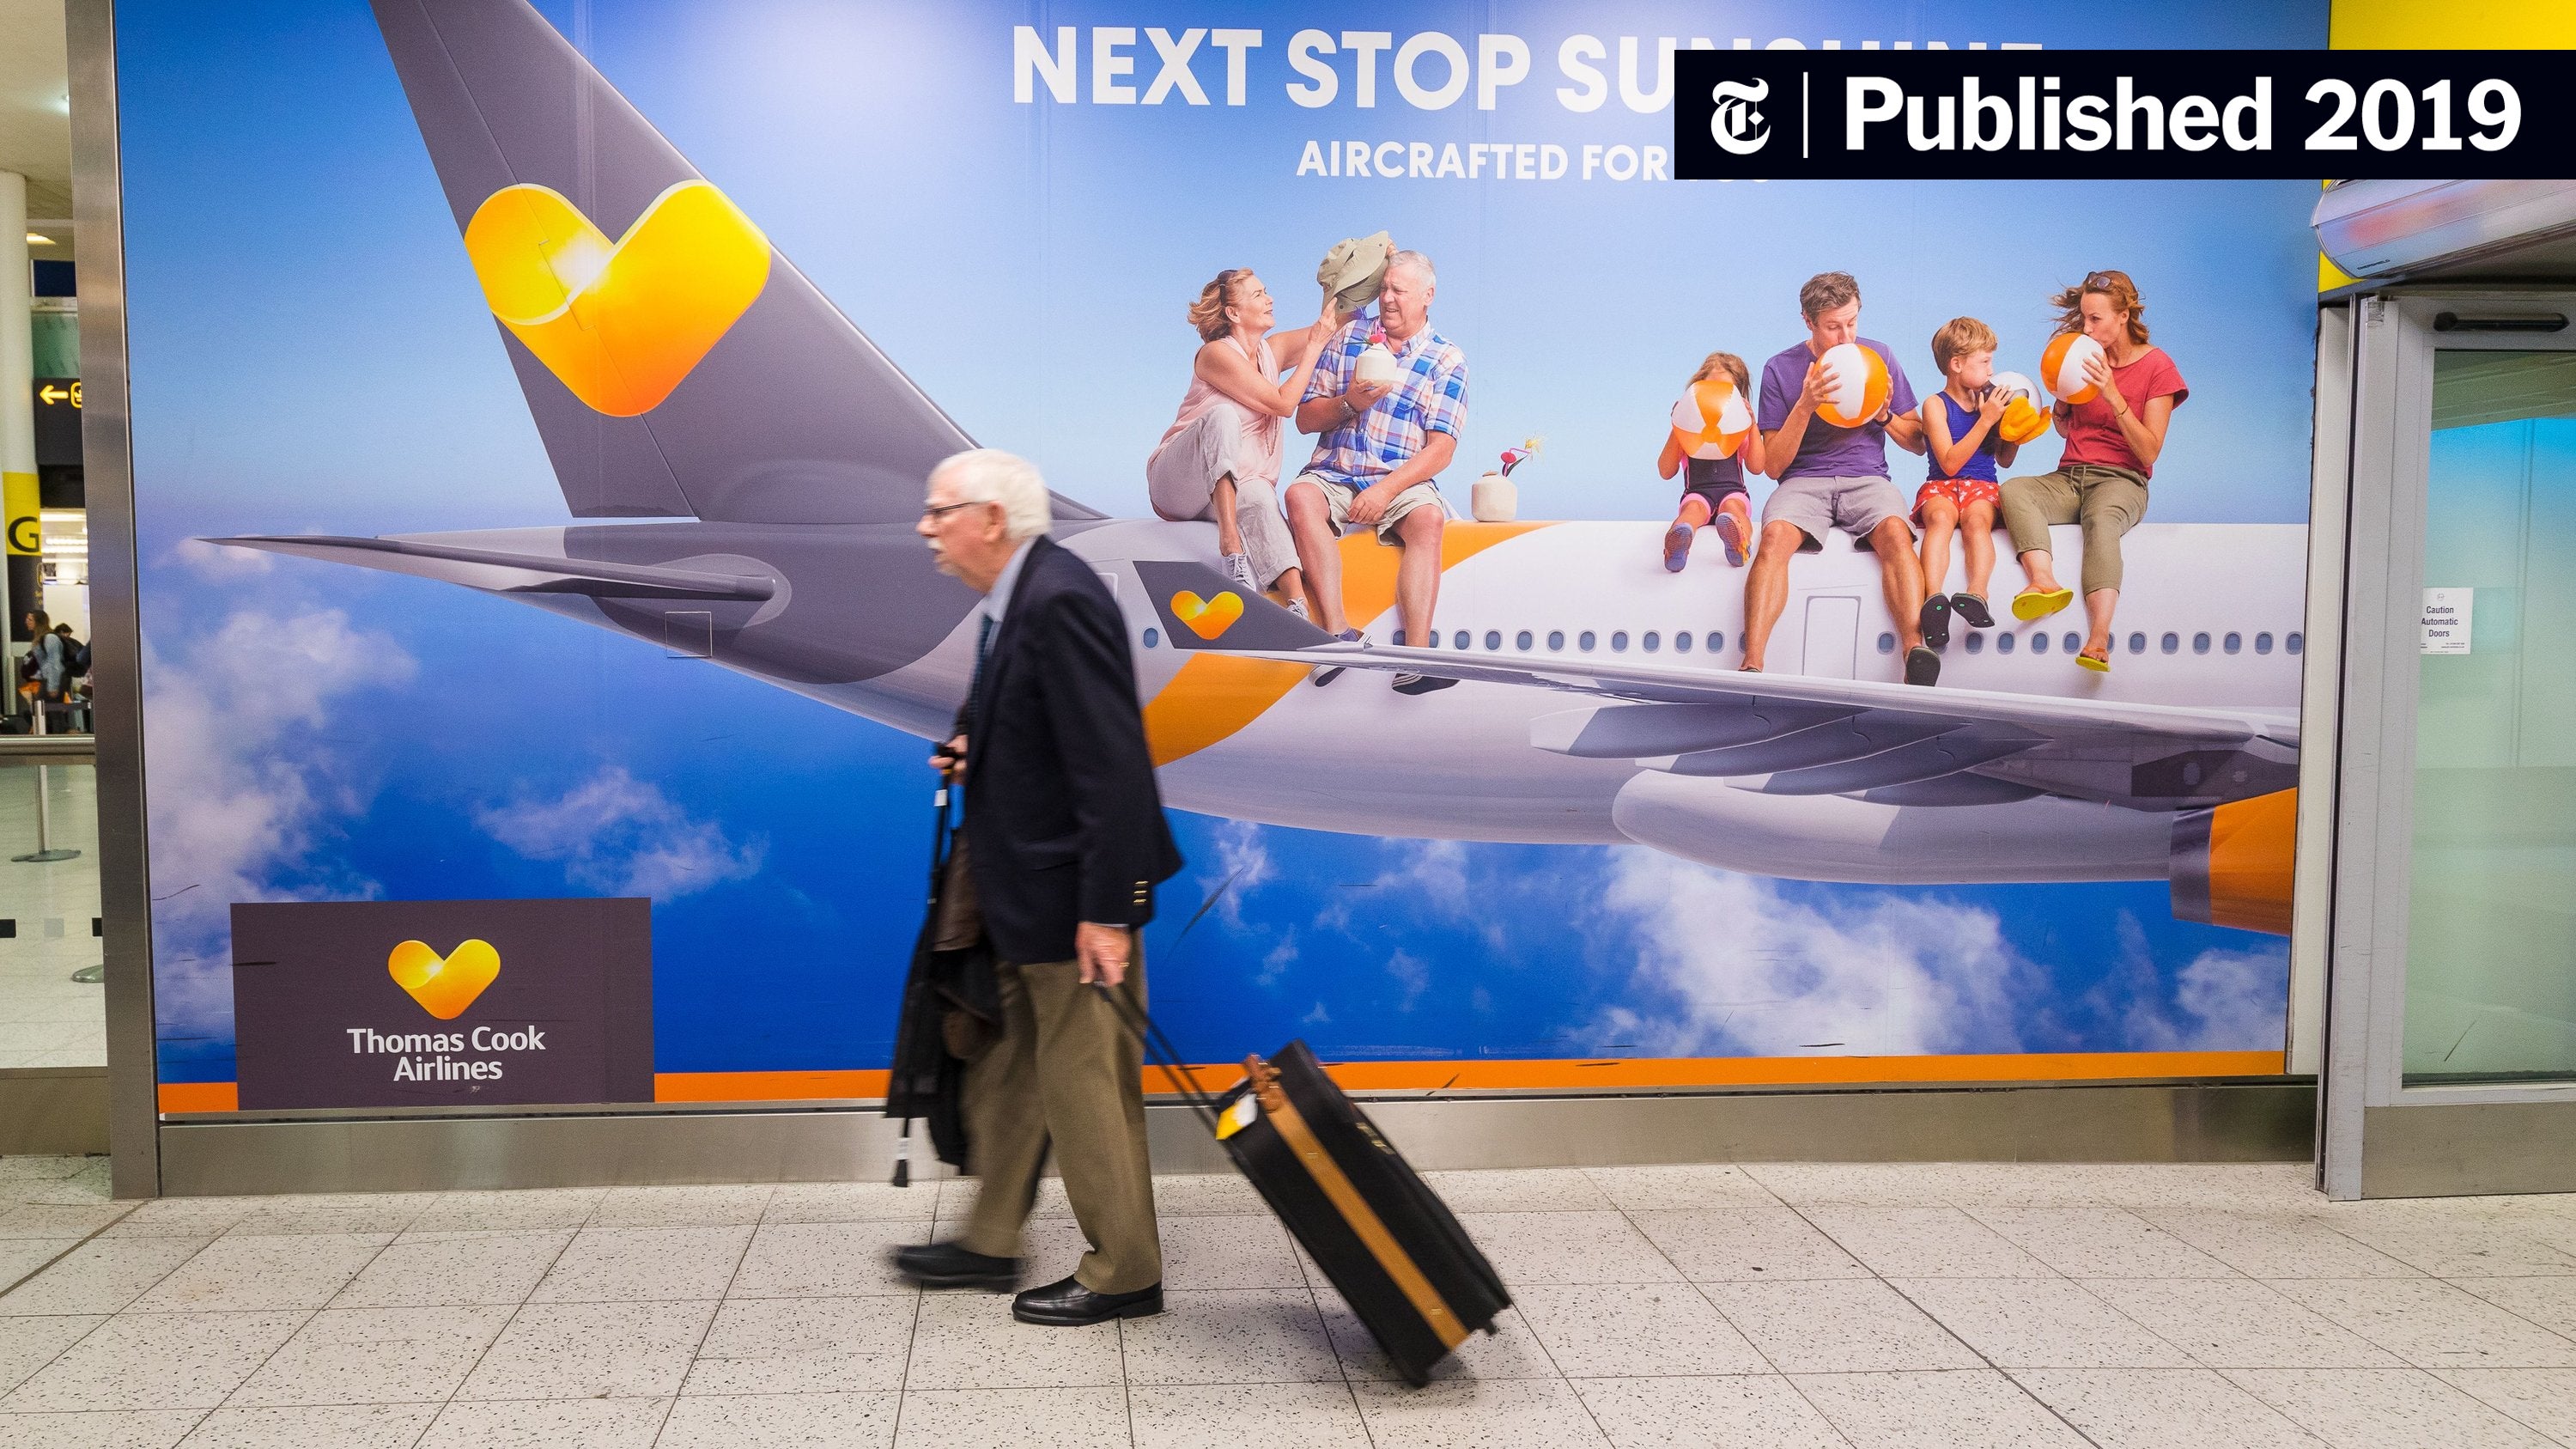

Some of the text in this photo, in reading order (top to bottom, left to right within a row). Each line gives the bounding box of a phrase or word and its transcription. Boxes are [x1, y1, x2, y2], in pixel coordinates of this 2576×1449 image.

[1013, 26, 1262, 106] NEXT
[1285, 29, 1531, 111] STOP
[1296, 140, 1669, 182] AIRCRAFTED FOR
[7, 515, 39, 553] G
[2421, 617, 2458, 625] Automatic
[2426, 606, 2454, 614] Caution
[2428, 629, 2450, 637] Doors
[346, 1025, 546, 1054] Thomas Cook
[393, 1055, 503, 1081] Airlines
